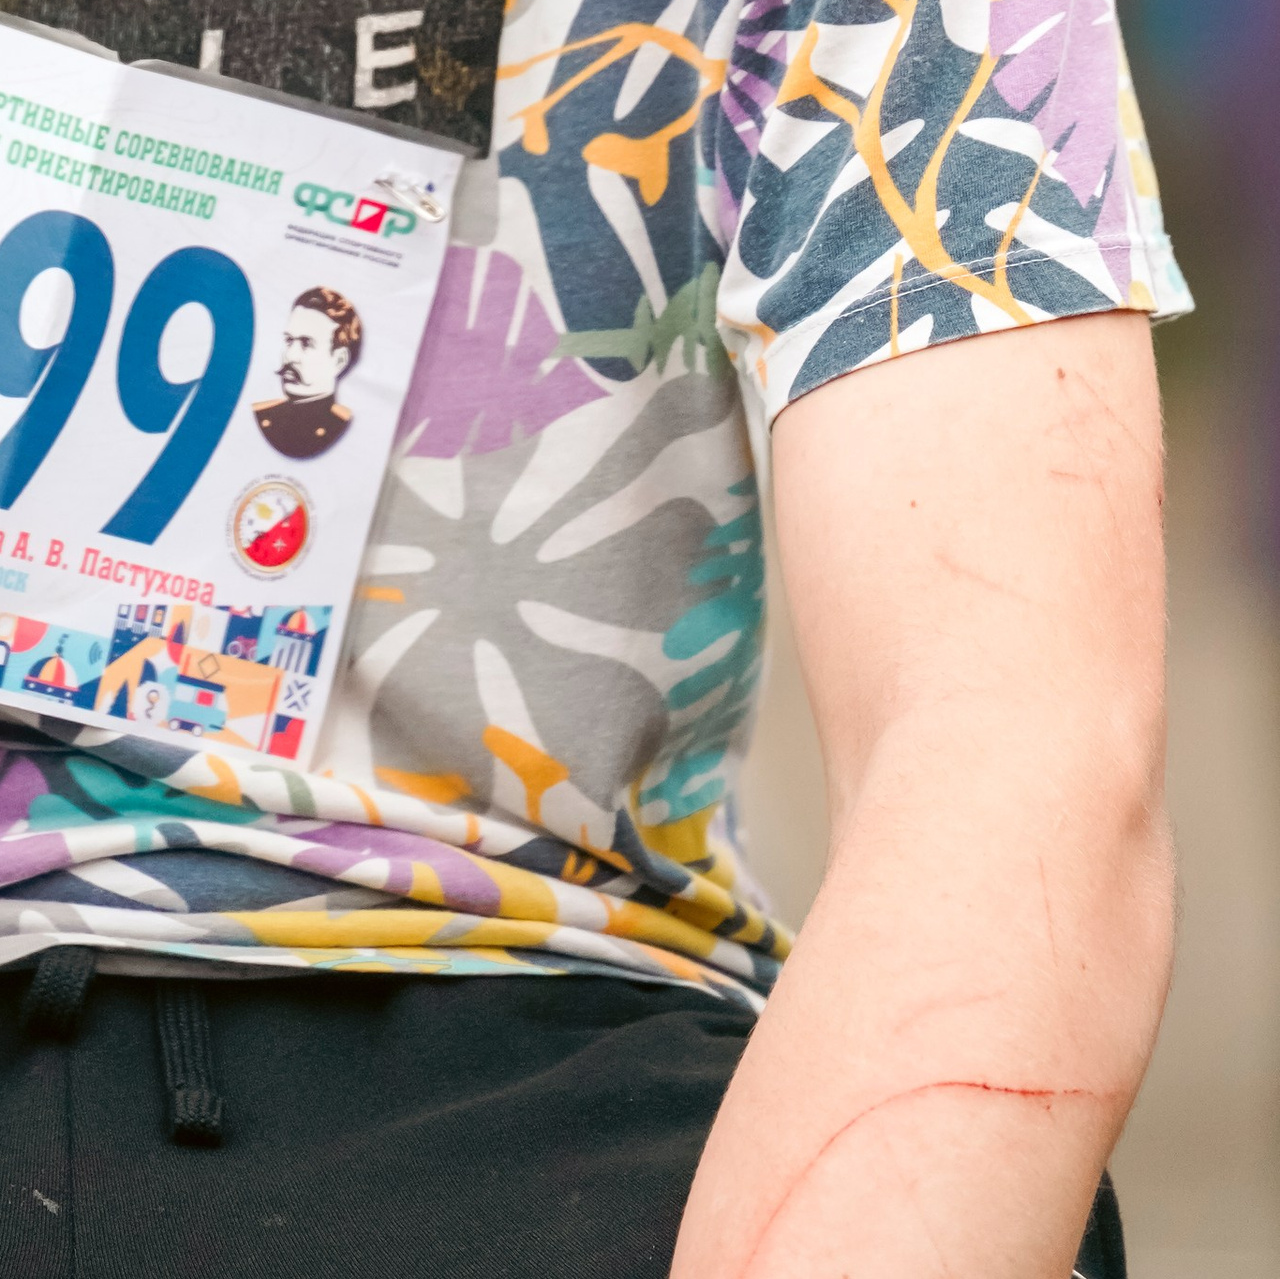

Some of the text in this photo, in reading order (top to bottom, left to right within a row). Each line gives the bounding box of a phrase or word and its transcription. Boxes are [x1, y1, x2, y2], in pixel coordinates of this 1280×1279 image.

[6, 139, 217, 220] ОРИЕНТИРОВАНИЮ
[114, 129, 284, 196] СОРЕВНОВАНИЯ
[10, 530, 34, 563] А.
[44, 538, 68, 570] В.
[78, 546, 216, 606] Пастухова
